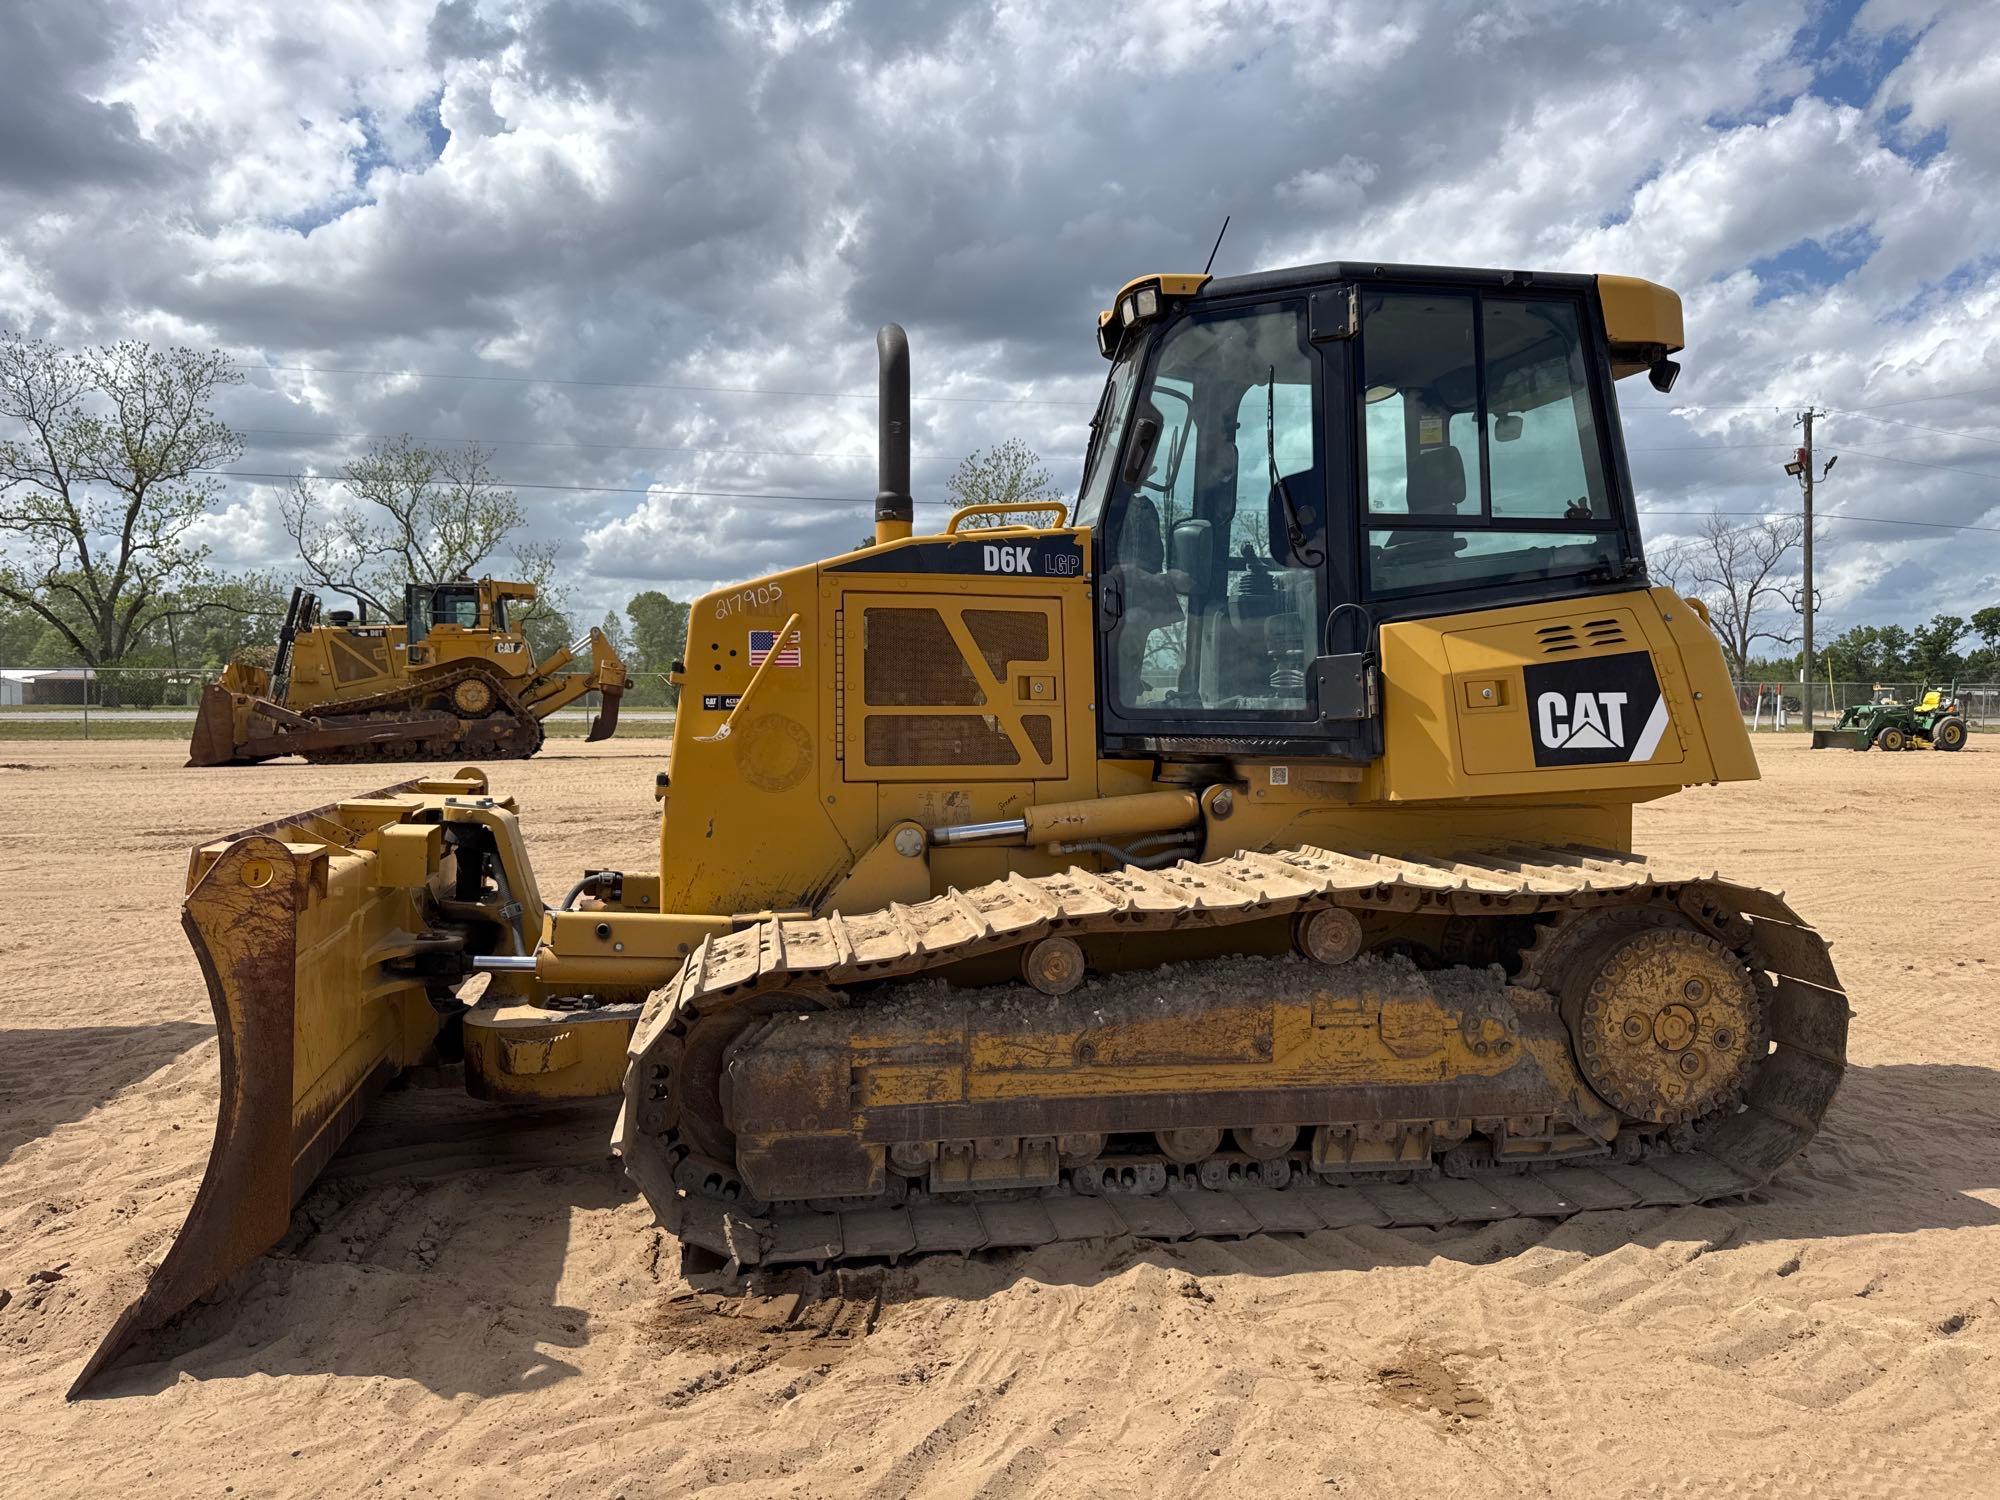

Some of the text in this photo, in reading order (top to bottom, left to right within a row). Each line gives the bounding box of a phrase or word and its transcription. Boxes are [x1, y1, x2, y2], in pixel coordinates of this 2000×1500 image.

[983, 545, 1080, 575] D6K LGP
[715, 582, 783, 620] 217905
[497, 642, 516, 654] CAT
[705, 697, 717, 705] CAT
[1537, 691, 1628, 749] CAT
